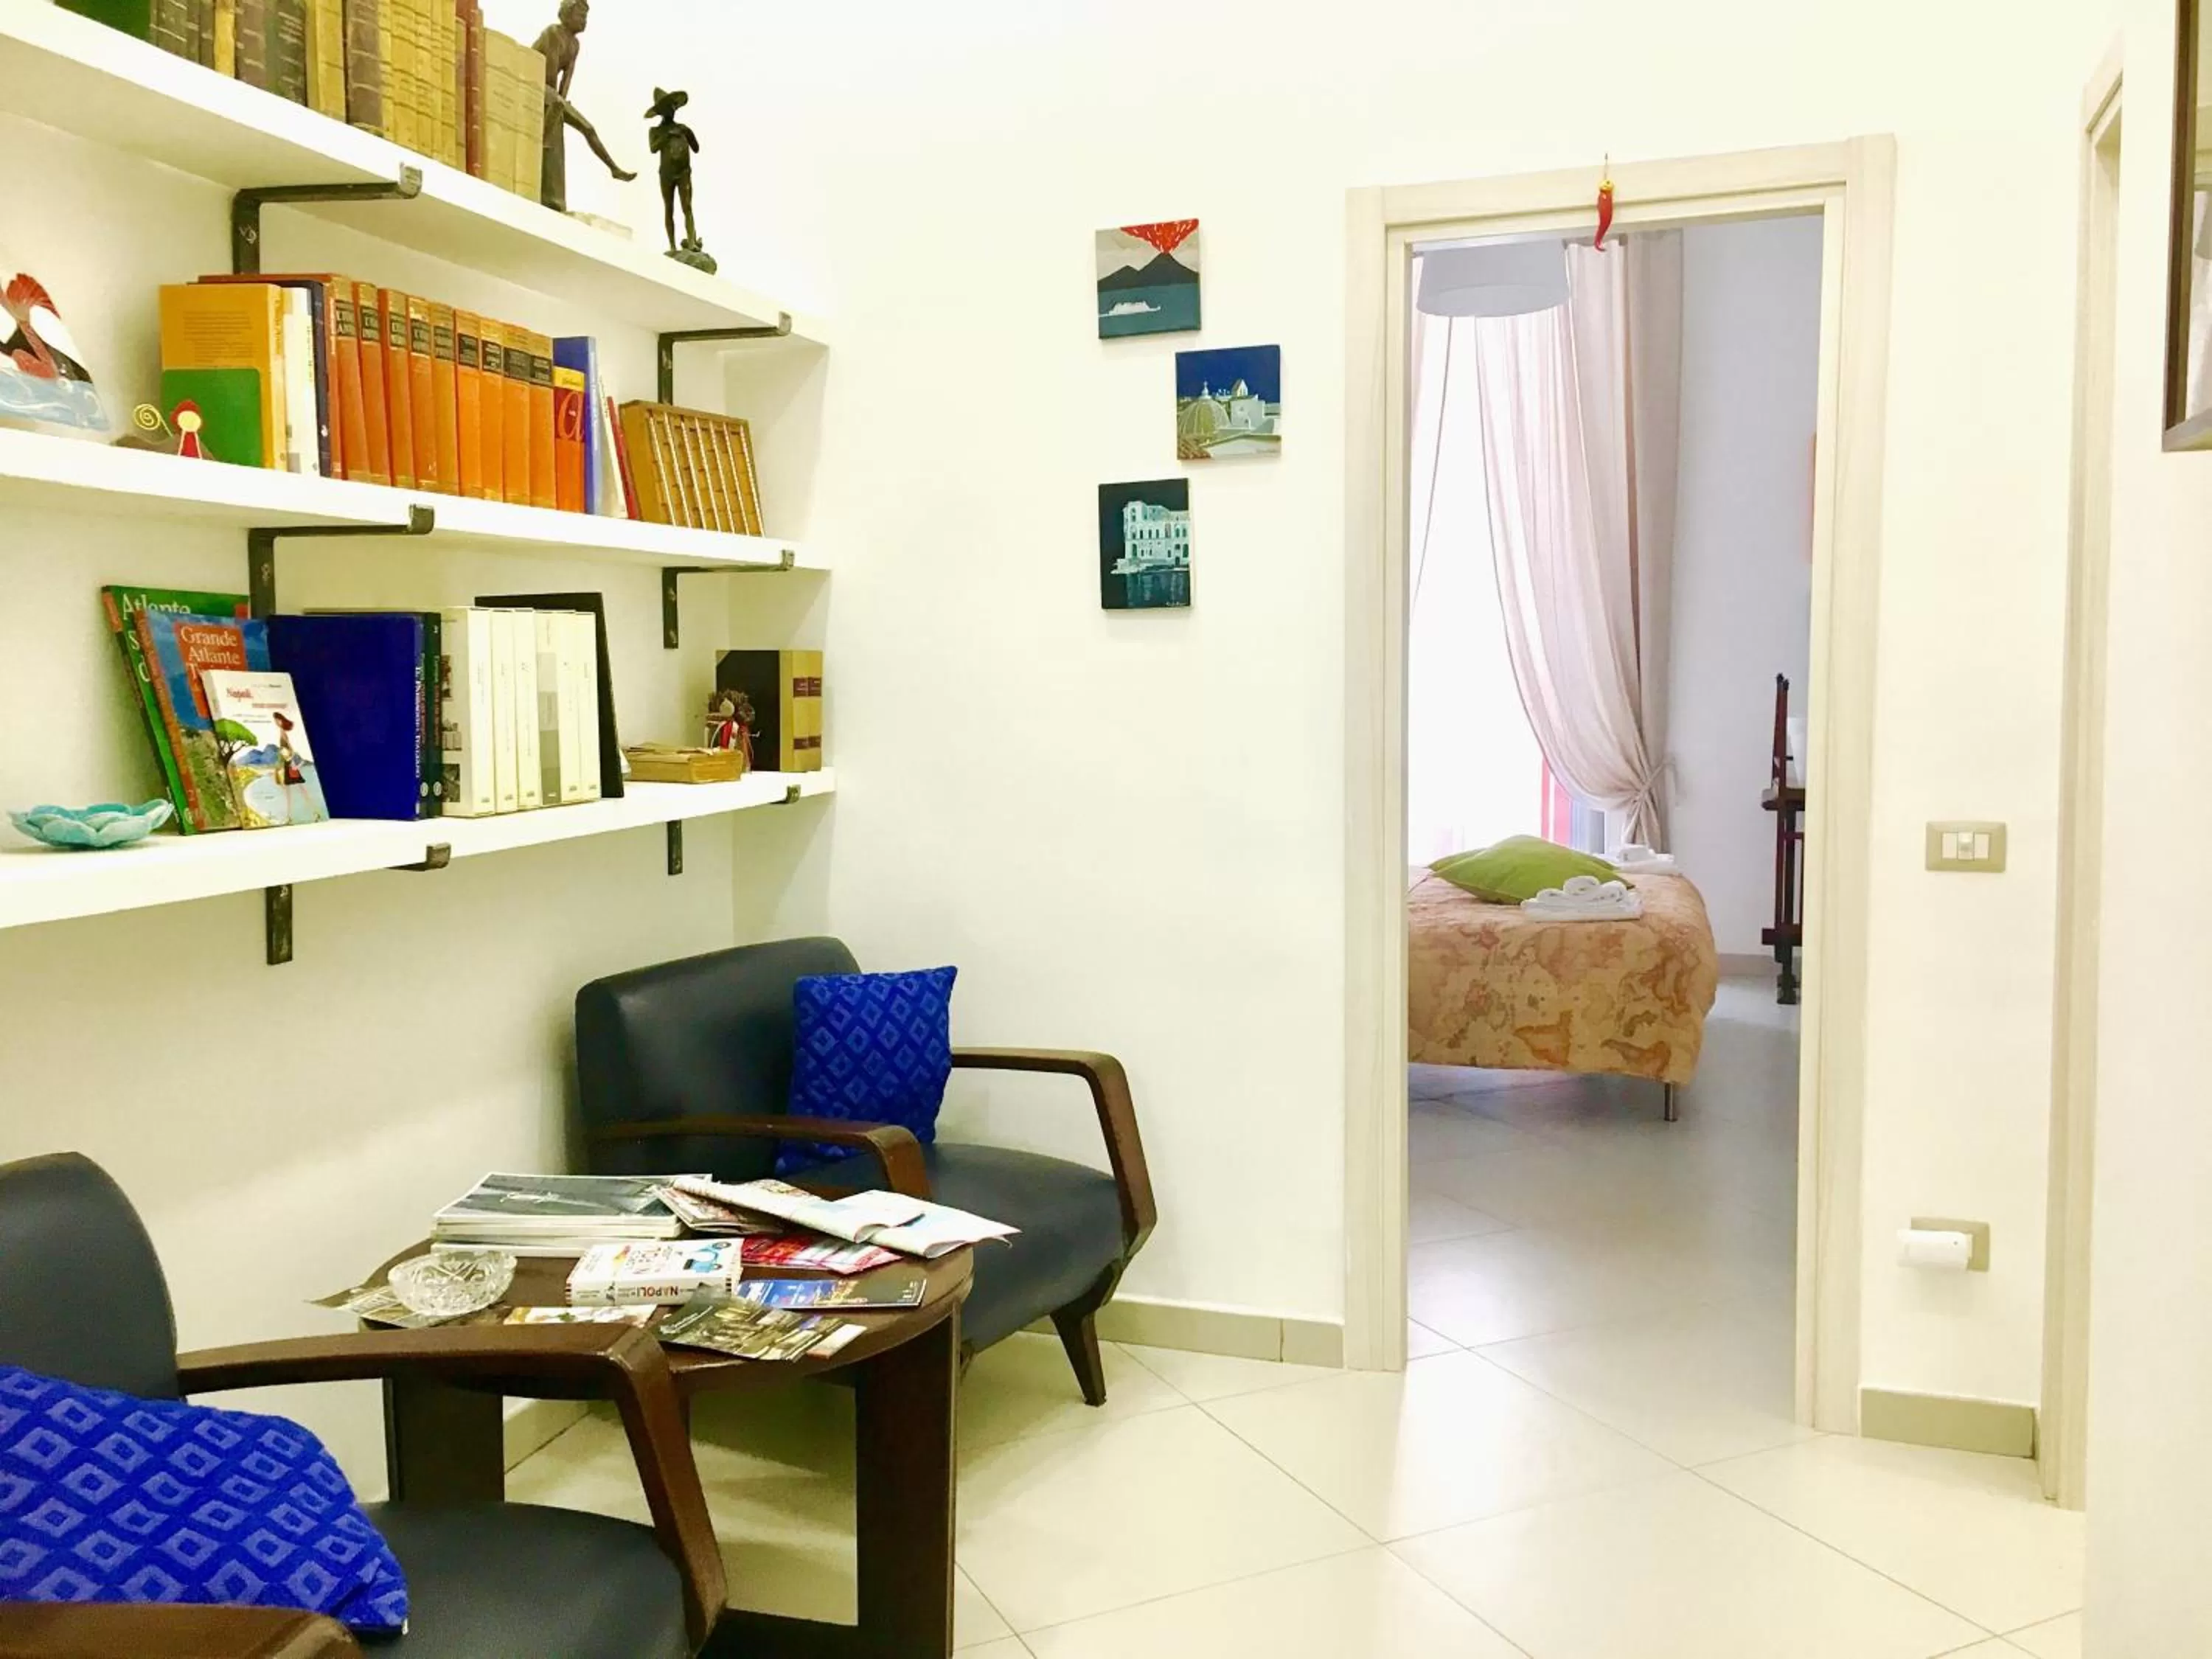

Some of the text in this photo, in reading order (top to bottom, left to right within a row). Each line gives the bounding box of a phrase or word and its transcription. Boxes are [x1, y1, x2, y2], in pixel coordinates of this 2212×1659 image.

[181, 625, 237, 647] Grande
[188, 645, 241, 665] Atlante
[636, 1285, 679, 1298] NAPOLI
